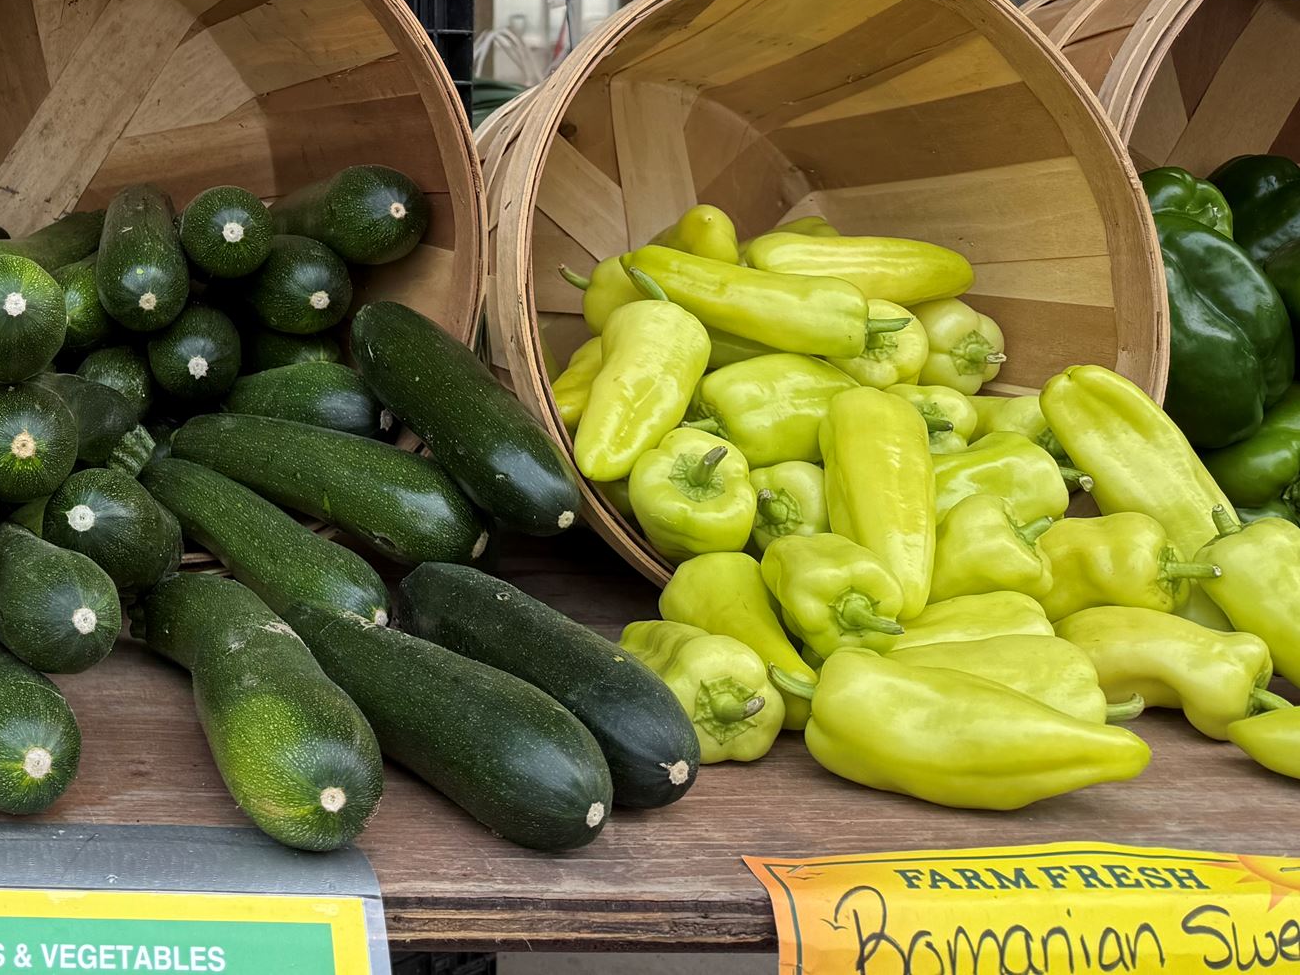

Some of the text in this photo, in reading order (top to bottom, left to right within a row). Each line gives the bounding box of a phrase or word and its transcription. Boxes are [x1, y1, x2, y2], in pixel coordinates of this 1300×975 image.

[893, 864, 1212, 890] FARM FRESH
[834, 885, 1165, 975] Romanian
[13, 942, 32, 968] &
[41, 943, 226, 972] VEGETABLES
